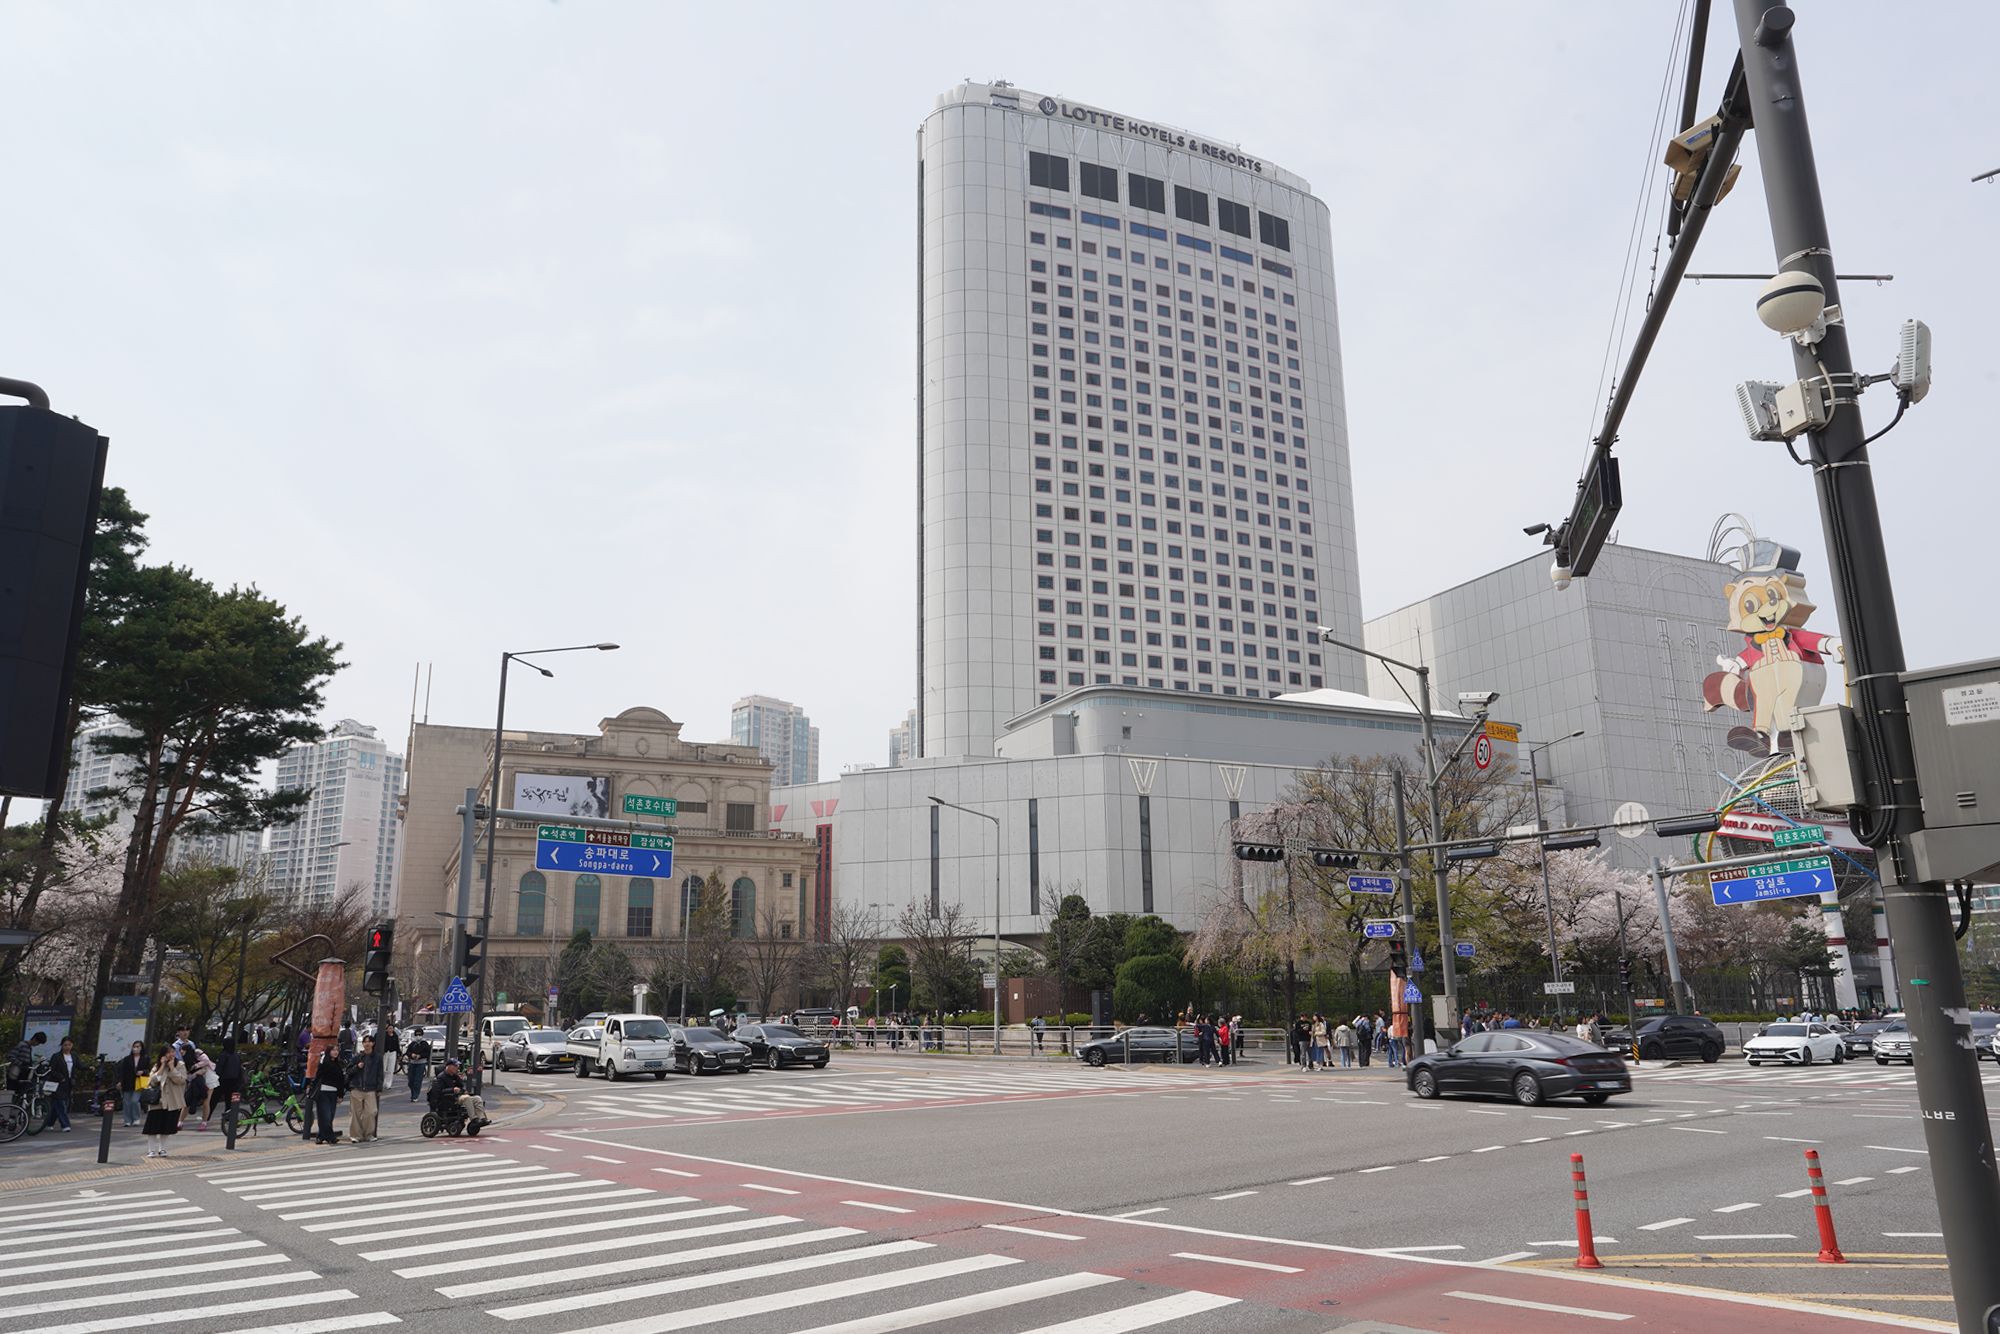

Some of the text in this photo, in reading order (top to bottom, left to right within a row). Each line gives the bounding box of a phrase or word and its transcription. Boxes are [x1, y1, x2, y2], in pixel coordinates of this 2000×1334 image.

[1062, 104, 1124, 131] LOTTE
[1129, 121, 1185, 147] HOTELS
[1189, 139, 1198, 151] &
[1202, 143, 1262, 173] RESORTS
[1479, 743, 1488, 761] 50
[627, 798, 675, 813] 석촌호수[북]
[550, 829, 577, 840] 석촌역
[1775, 828, 1822, 844] 석촌호수[북]
[640, 837, 665, 848] 잠실역
[584, 847, 630, 860] 송파대로
[578, 859, 634, 871] Songpa-daero
[1760, 865, 1781, 874] 잠실역
[1797, 859, 1819, 869] 오금로
[1755, 876, 1787, 890] 잠실로
[1755, 887, 1791, 898] Jamsil-ro
